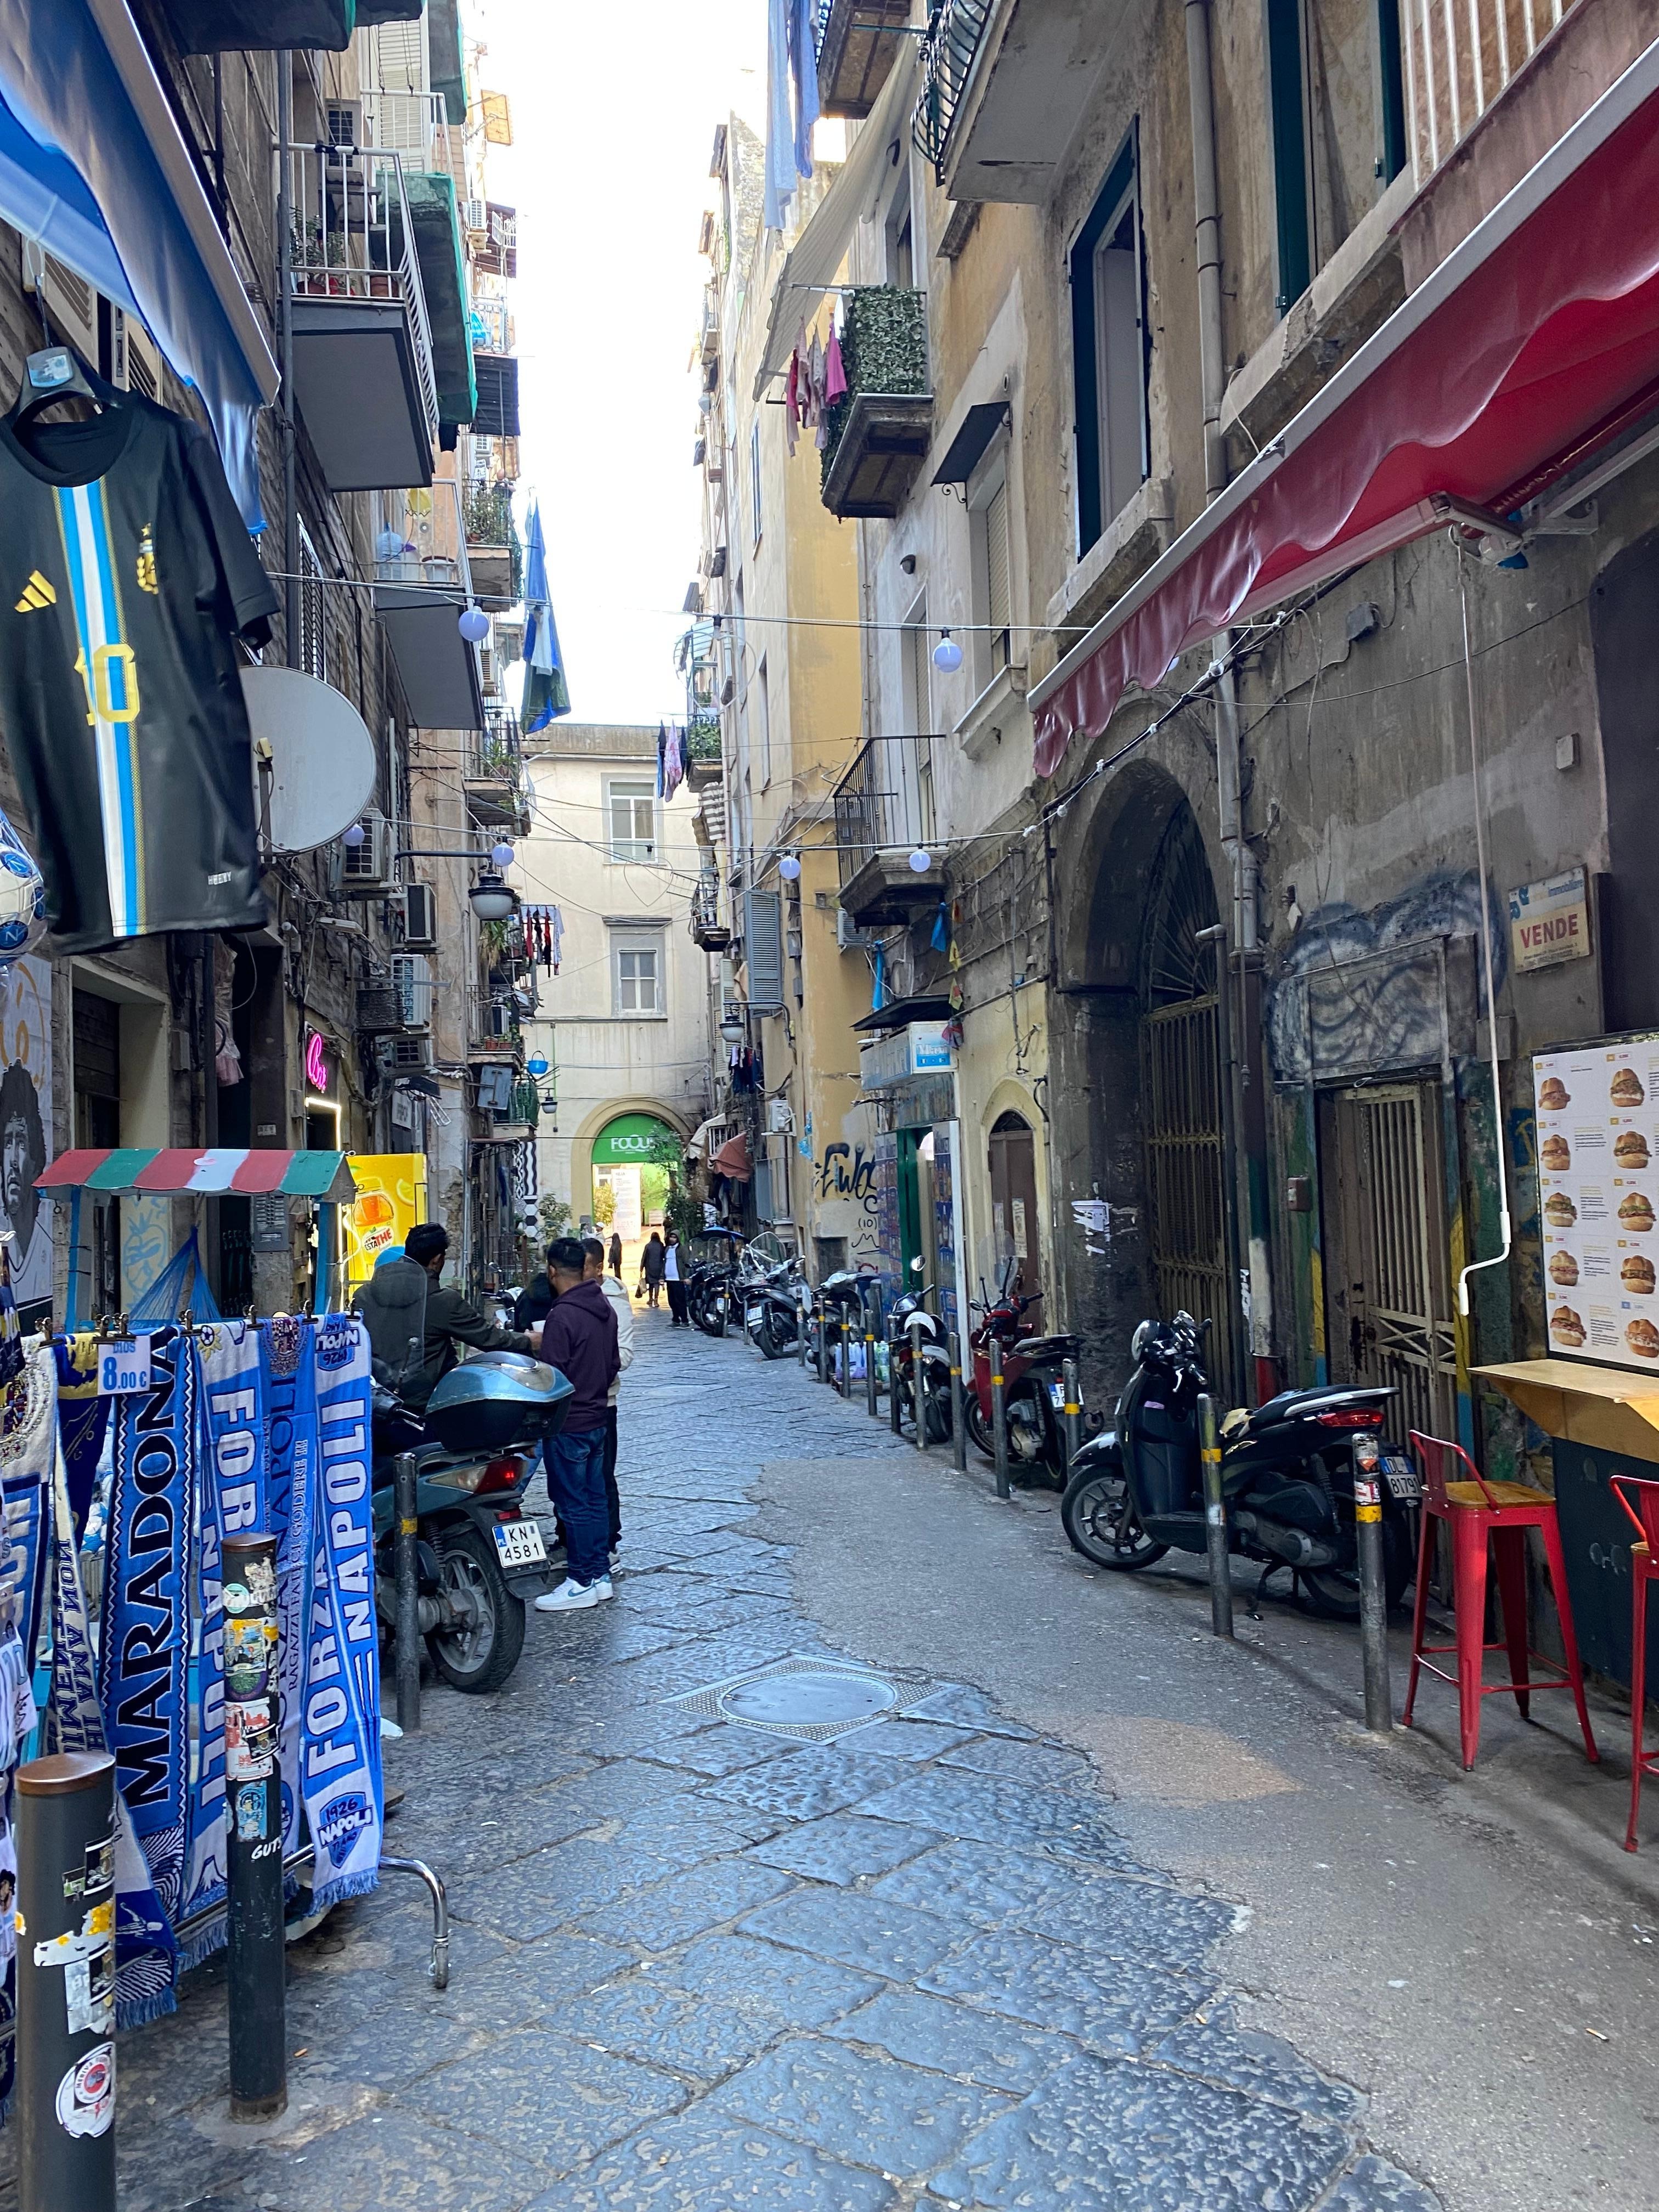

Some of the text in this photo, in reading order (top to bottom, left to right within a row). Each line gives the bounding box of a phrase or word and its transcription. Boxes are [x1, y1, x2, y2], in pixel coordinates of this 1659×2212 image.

[74, 644, 140, 726] 10
[1520, 913, 1579, 949] VENDE
[103, 1357, 146, 1390] 8.00 €
[1386, 1457, 1403, 1474] DL
[290, 1459, 307, 1538] GODERE
[504, 1542, 540, 1561] 4581
[507, 1526, 528, 1543] KN
[114, 1325, 180, 1809] MARADONA
[307, 1399, 372, 1778] FORZA NAPOLI
[319, 1808, 373, 1846] NAPOLI
[325, 1797, 358, 1822] 1926
